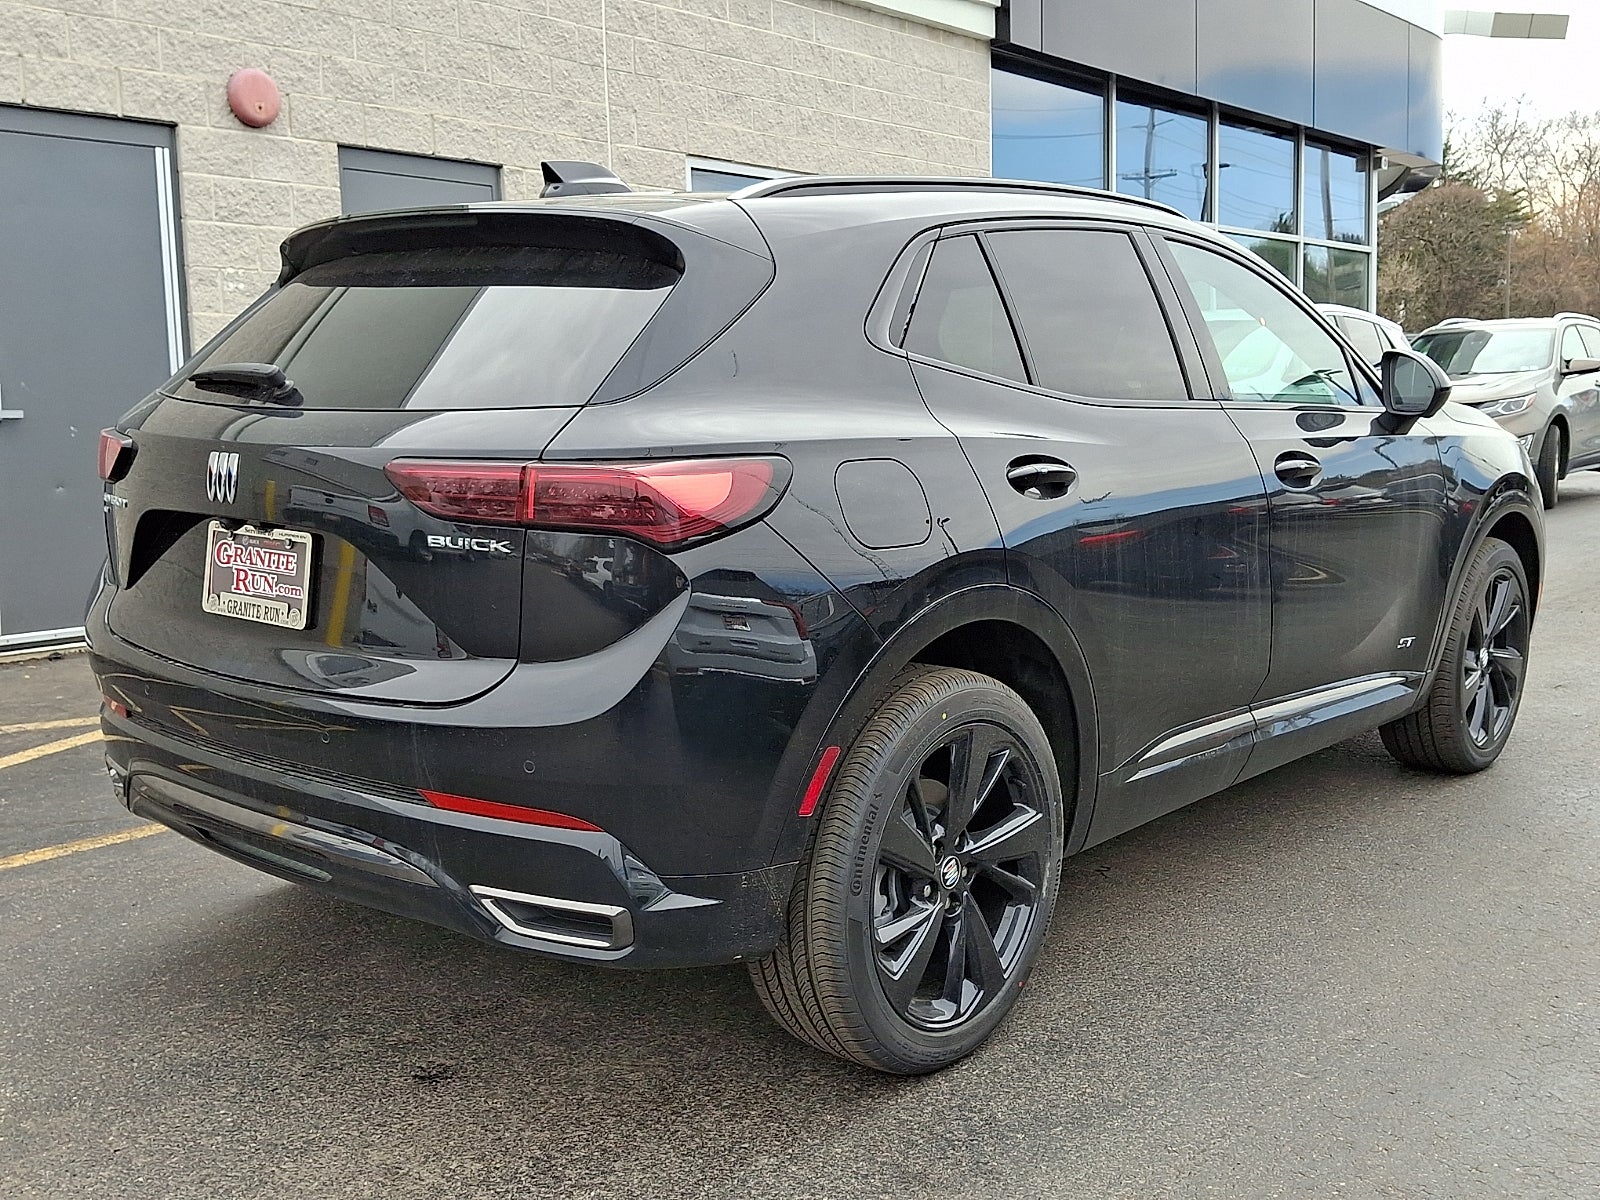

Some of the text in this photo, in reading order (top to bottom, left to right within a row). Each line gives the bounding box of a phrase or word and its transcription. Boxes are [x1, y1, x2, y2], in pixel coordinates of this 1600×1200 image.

[215, 541, 296, 572] GRANITE
[427, 535, 512, 553] BUICK
[233, 567, 303, 597] RUN.com
[227, 599, 280, 623] GRANITE RUN
[1397, 636, 1417, 649] ST
[850, 803, 879, 897] Continental
